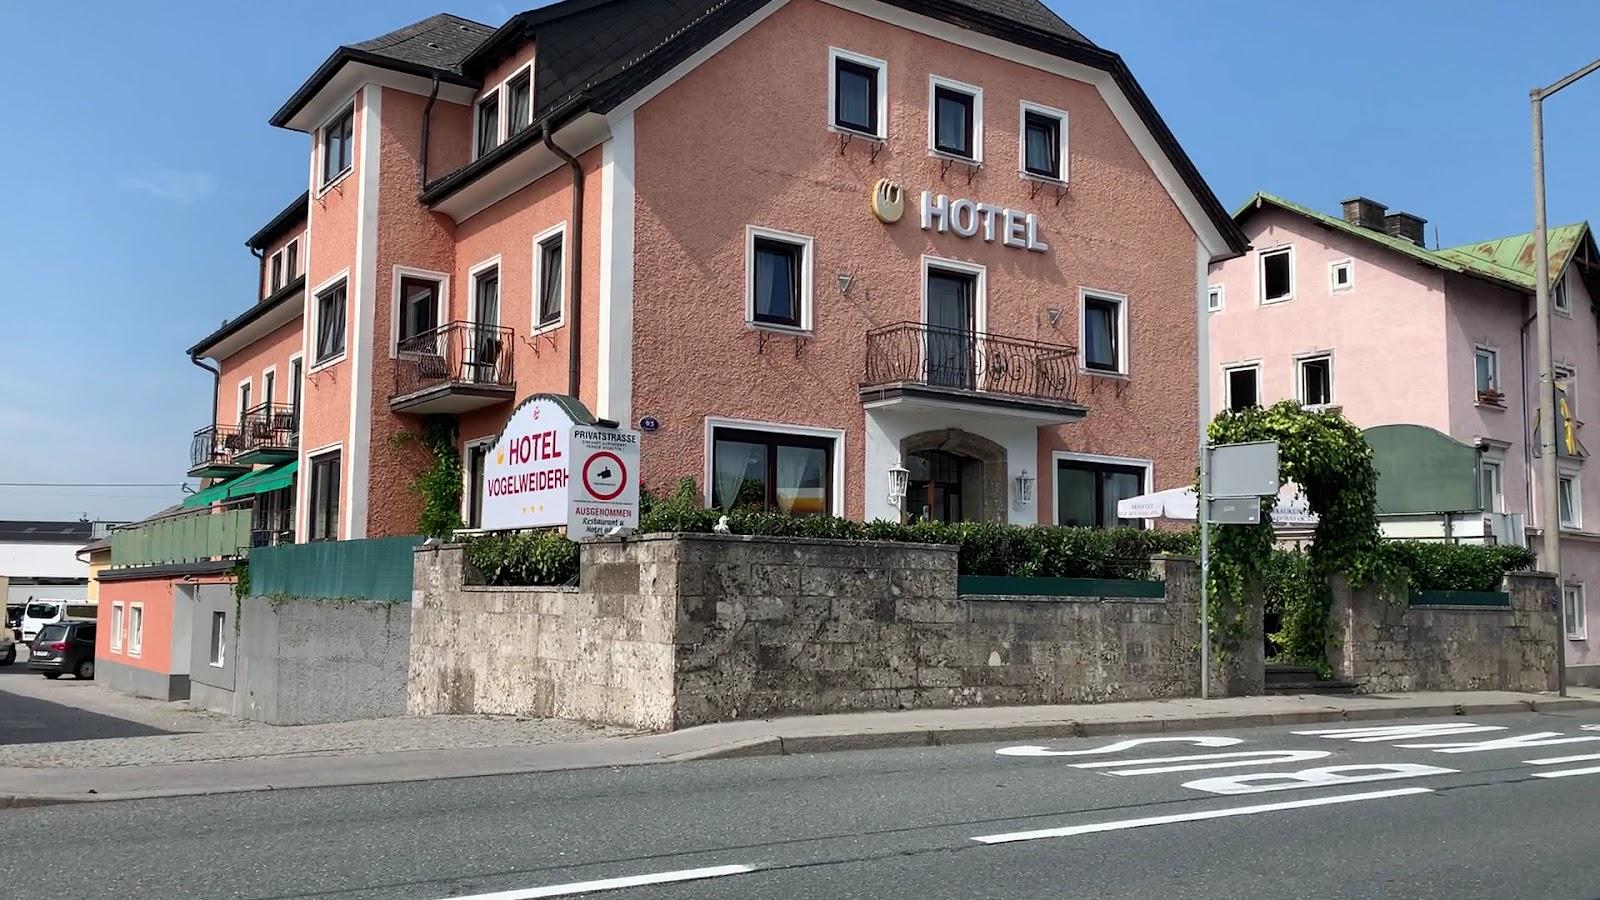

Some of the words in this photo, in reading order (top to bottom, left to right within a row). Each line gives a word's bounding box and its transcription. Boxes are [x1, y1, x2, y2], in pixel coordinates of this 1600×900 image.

[920, 190, 1048, 253] HOTEL
[509, 430, 562, 466] HOTEL
[574, 430, 636, 444] PRIVATSTRASSE
[575, 507, 632, 518] AUSGENOMMEN
[995, 735, 1462, 795] BUS
